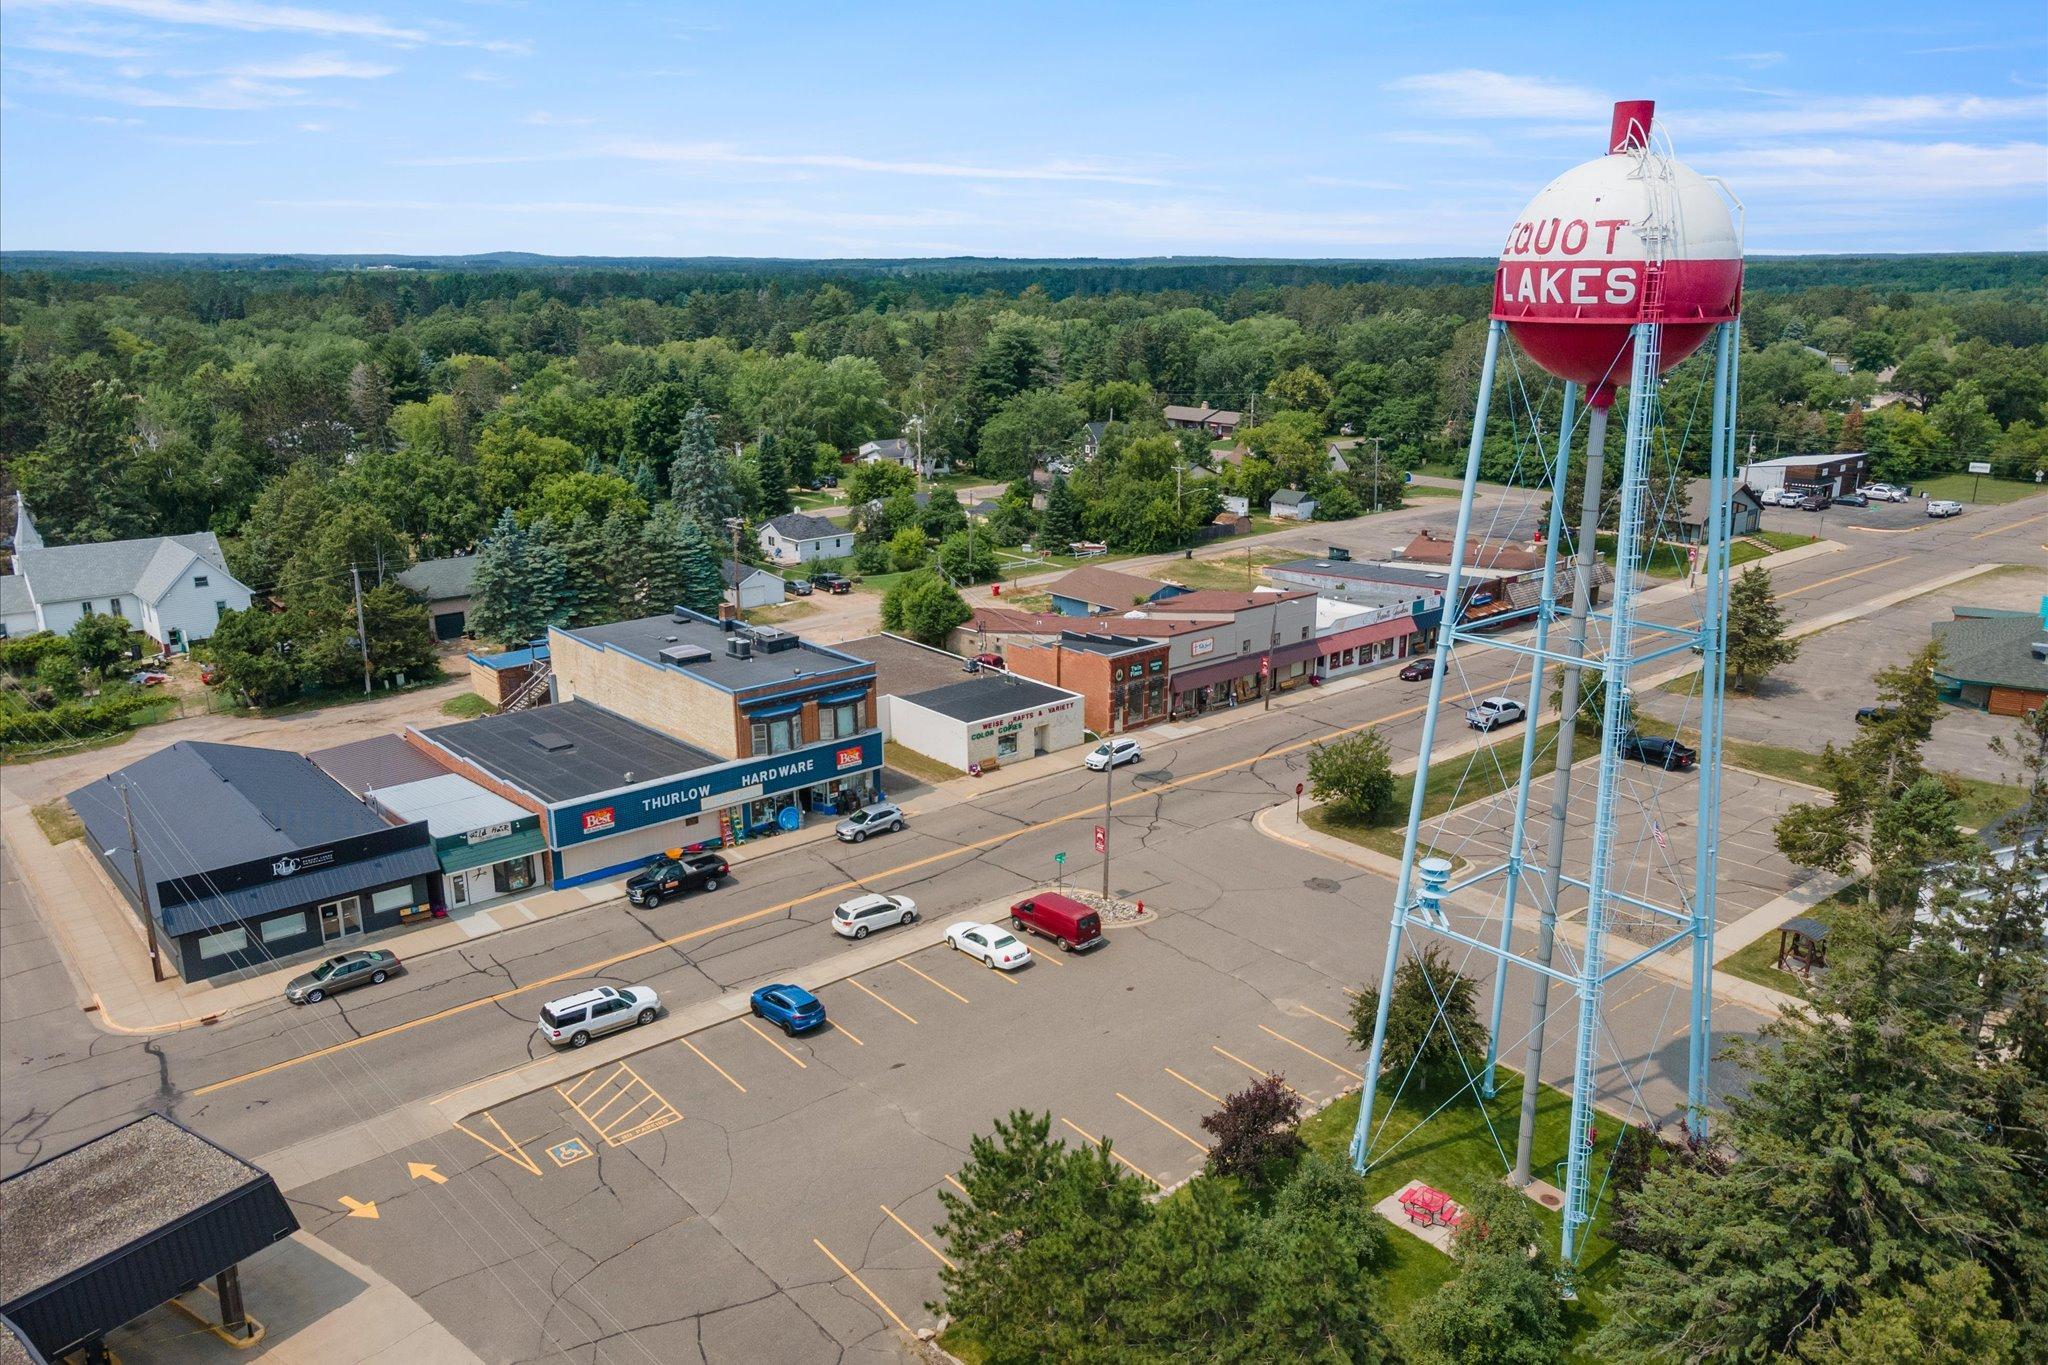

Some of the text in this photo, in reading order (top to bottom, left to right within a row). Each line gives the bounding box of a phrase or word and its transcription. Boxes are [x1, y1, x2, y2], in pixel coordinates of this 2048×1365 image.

[1502, 267, 1637, 304] LAKES
[982, 719, 1004, 730] WEISE
[1048, 702, 1075, 714] VARIETY
[971, 729, 994, 741] COLOR
[840, 752, 860, 765] Best
[642, 759, 814, 811] THURLOW HARDWARE
[586, 813, 612, 828] Best
[272, 857, 301, 876] PLC
